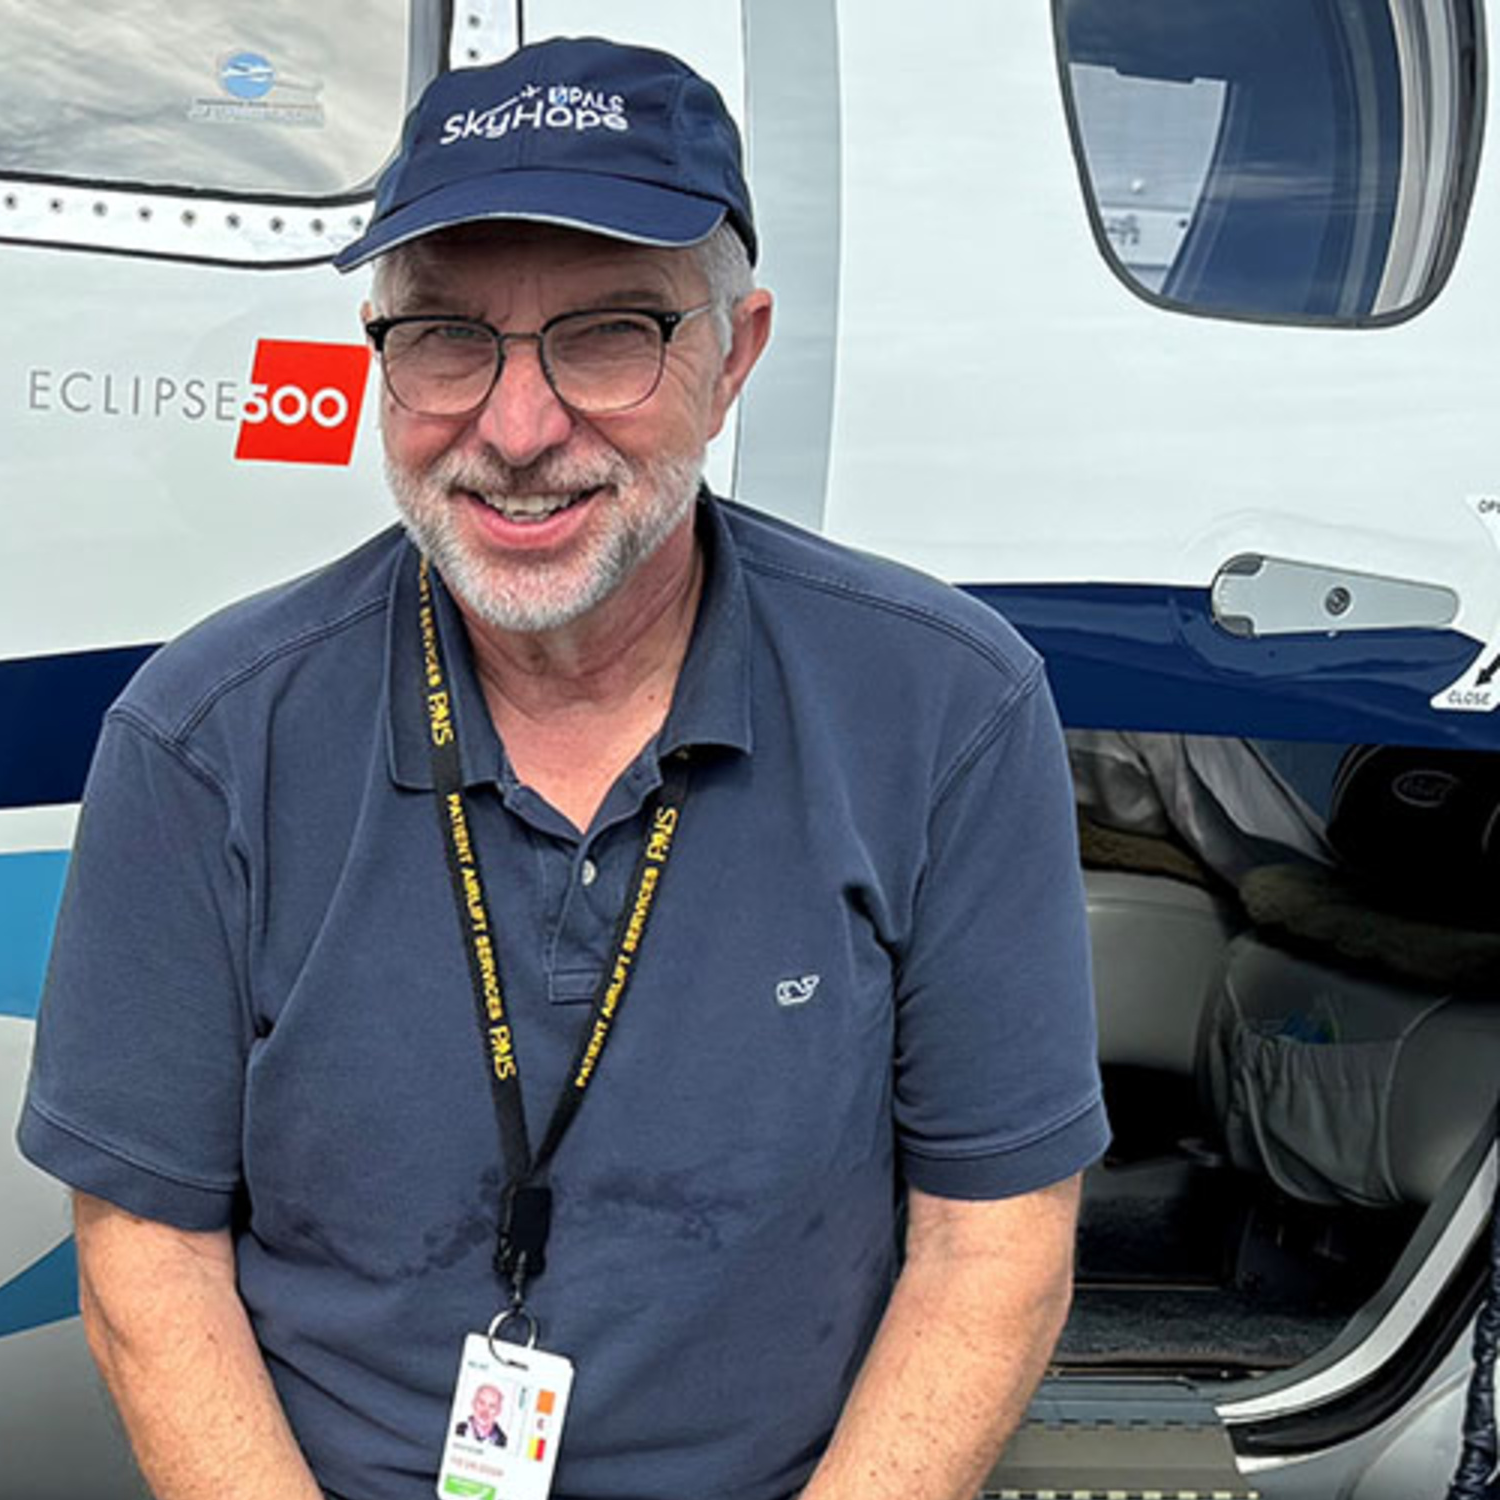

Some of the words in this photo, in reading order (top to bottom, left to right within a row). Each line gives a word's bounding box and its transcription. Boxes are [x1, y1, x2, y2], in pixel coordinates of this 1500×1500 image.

[29, 369, 238, 421] ECLIPSE
[240, 383, 348, 428] 500
[1448, 690, 1492, 706] CLOSE
[447, 793, 473, 864] PATIENT
[461, 867, 488, 932] AIRLIFT
[474, 935, 504, 1021] SERVICES
[575, 1019, 609, 1088] PATIENT
[623, 866, 659, 952] SERVICES
